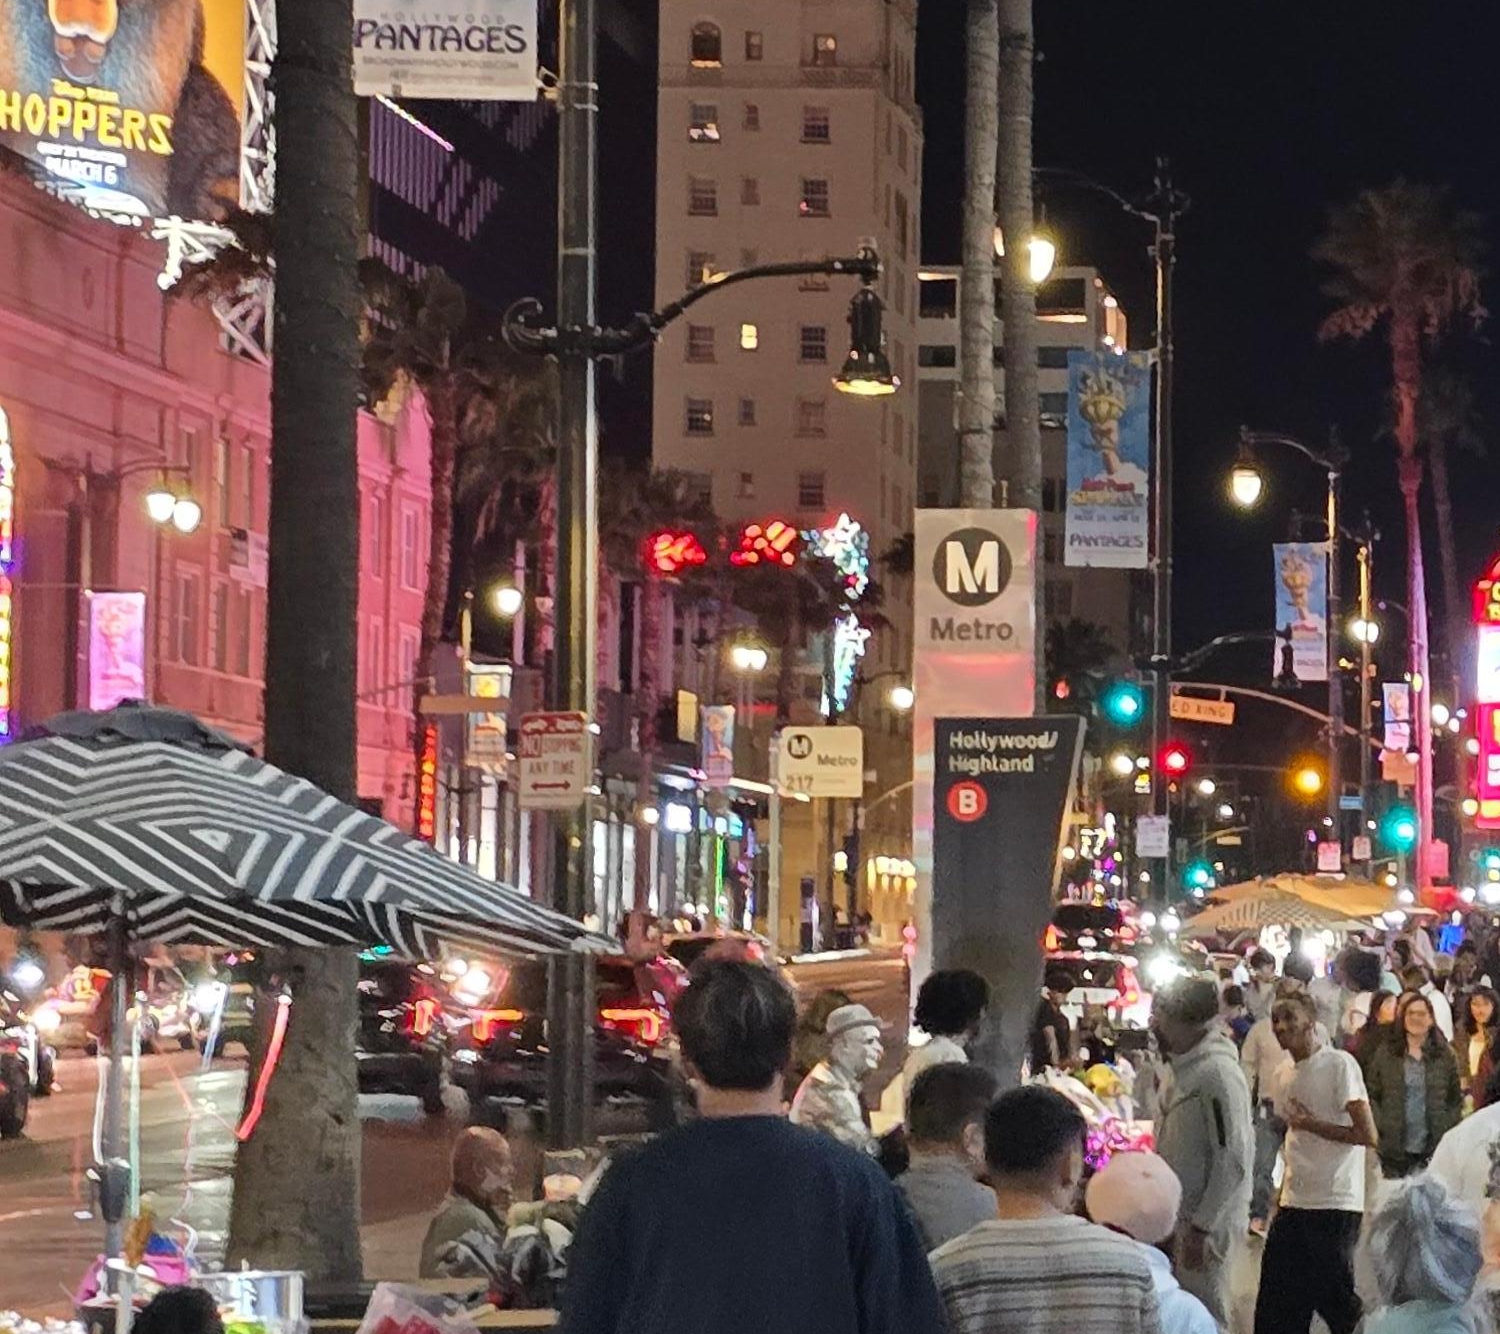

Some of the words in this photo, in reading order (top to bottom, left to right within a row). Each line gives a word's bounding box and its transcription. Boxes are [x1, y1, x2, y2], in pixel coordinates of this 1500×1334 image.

[353, 18, 528, 54] PANTAGES
[0, 88, 174, 156] HOPPERS
[103, 164, 118, 185] 6
[945, 540, 999, 593] M
[930, 618, 1013, 642] Metro
[949, 731, 1058, 753] Hollywood/
[817, 754, 858, 766] Metro
[949, 754, 1034, 774] Highland
[786, 775, 814, 791] 217
[958, 789, 978, 814] B
